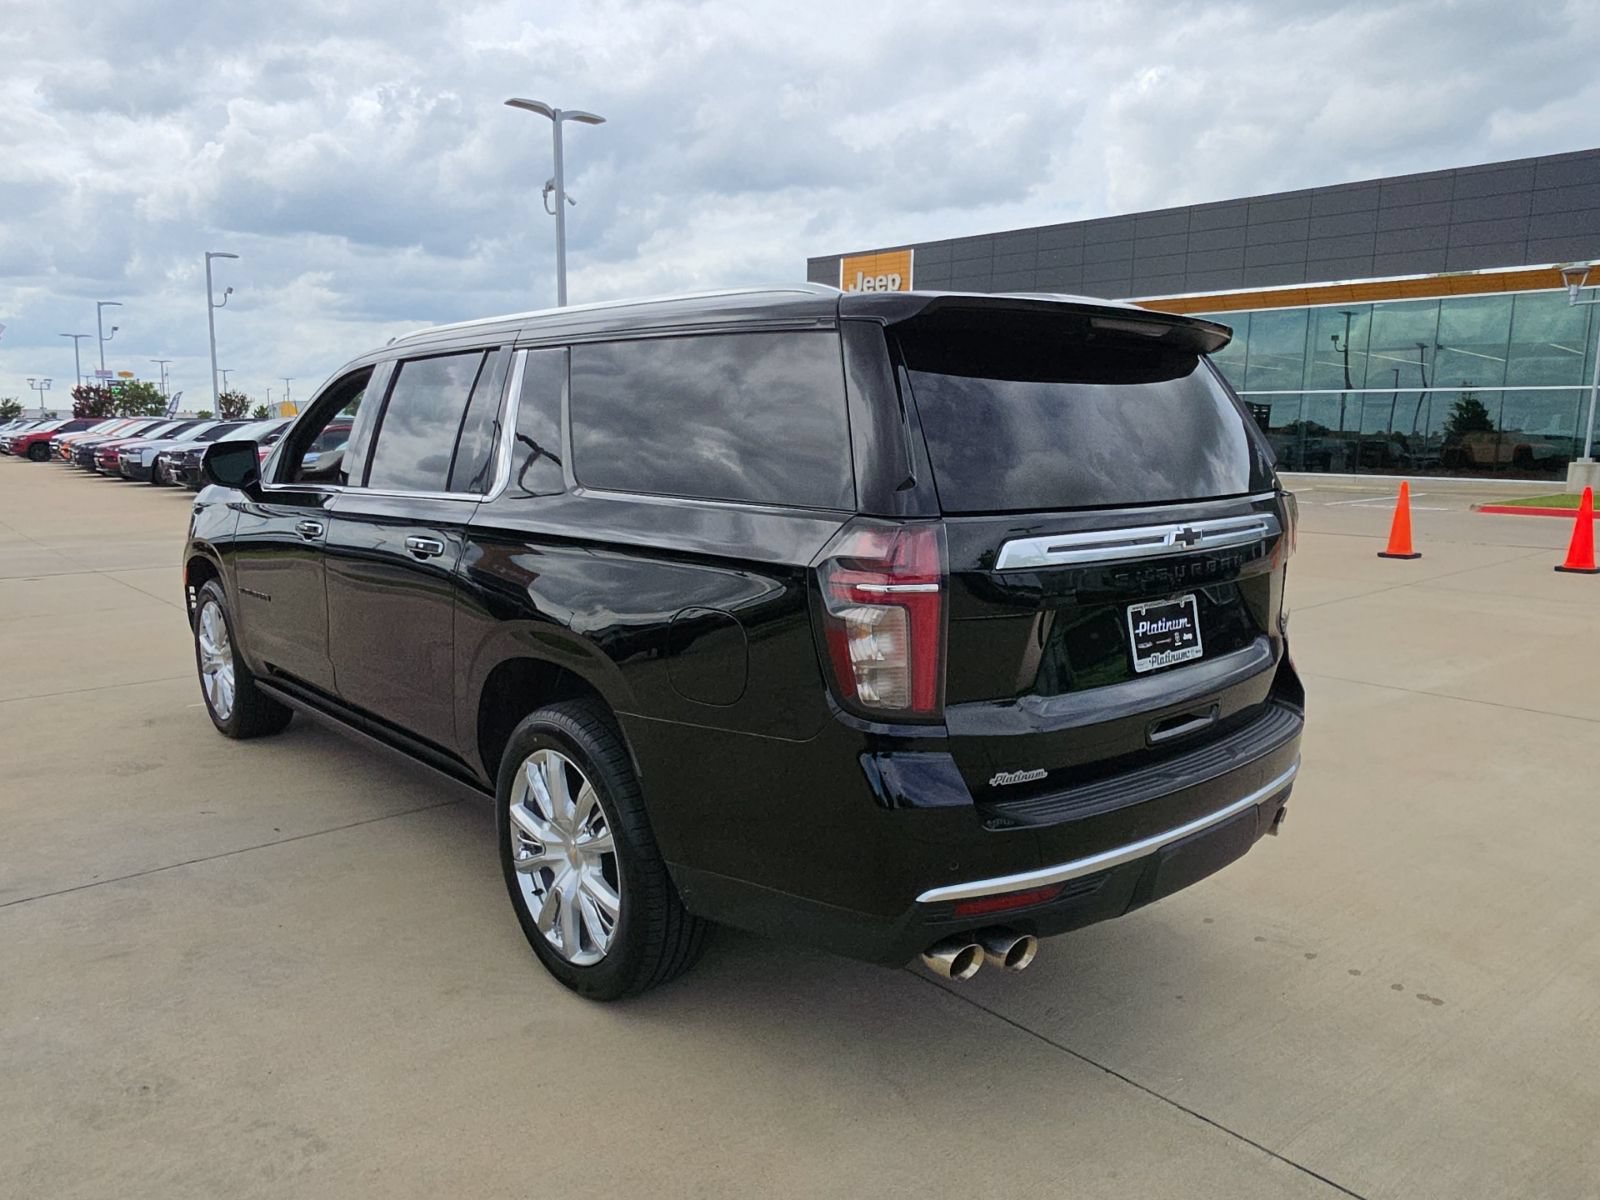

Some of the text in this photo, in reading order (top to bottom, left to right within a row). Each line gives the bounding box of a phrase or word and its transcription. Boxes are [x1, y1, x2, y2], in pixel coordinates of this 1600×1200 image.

[848, 271, 902, 292] Jeep
[1135, 617, 1191, 637] Platinum
[989, 768, 1048, 787] Platinum
